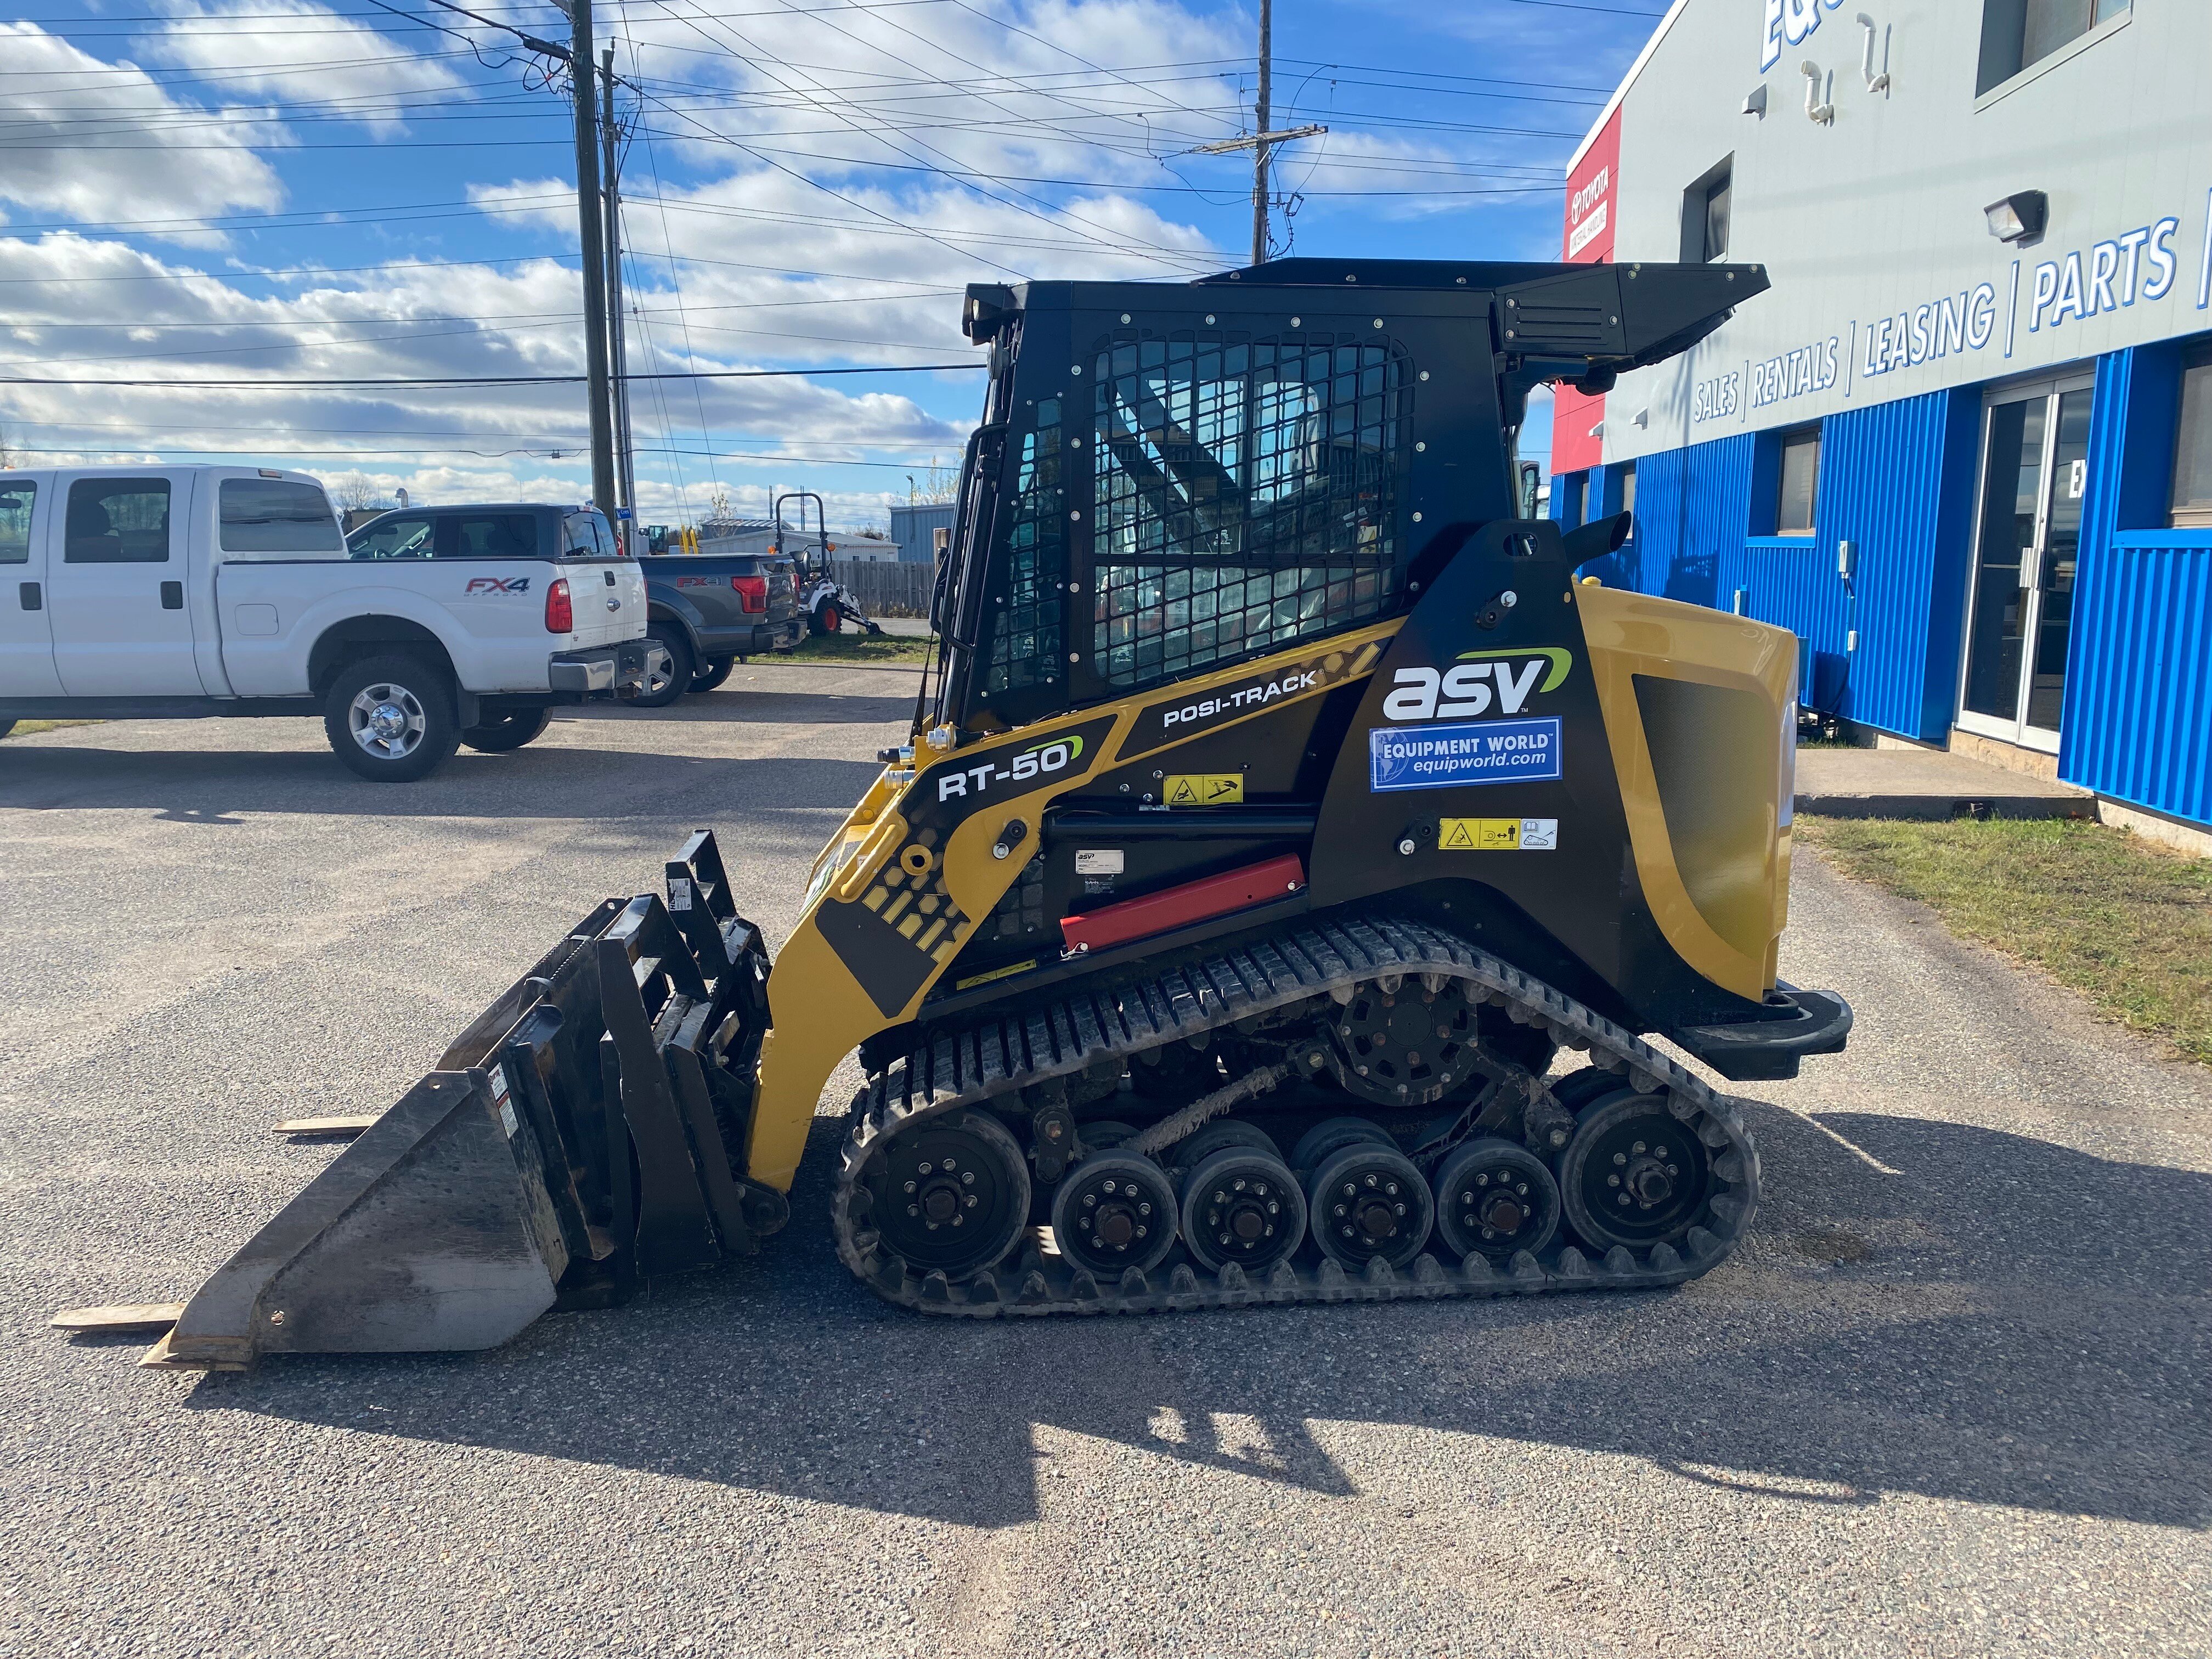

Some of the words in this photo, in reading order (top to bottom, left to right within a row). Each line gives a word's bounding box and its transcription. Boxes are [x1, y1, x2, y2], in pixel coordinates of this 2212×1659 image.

[1760, 0, 1845, 75] EQ
[1581, 165, 1609, 213] TOYOTA
[1694, 371, 1739, 423] SALES
[1752, 336, 1839, 408] RENTALS
[1863, 282, 1995, 378] LEASING
[2029, 216, 2180, 332] PARTS
[465, 577, 531, 593] FX4
[676, 577, 723, 588] FX4
[1164, 669, 1317, 728] POSI-TRACK
[1383, 659, 1546, 721] asv
[938, 743, 1068, 802] RT-50
[1383, 737, 1480, 759] EQUIPMENT
[1487, 733, 1549, 752] WORLD
[1413, 752, 1547, 773] equipworld.com
